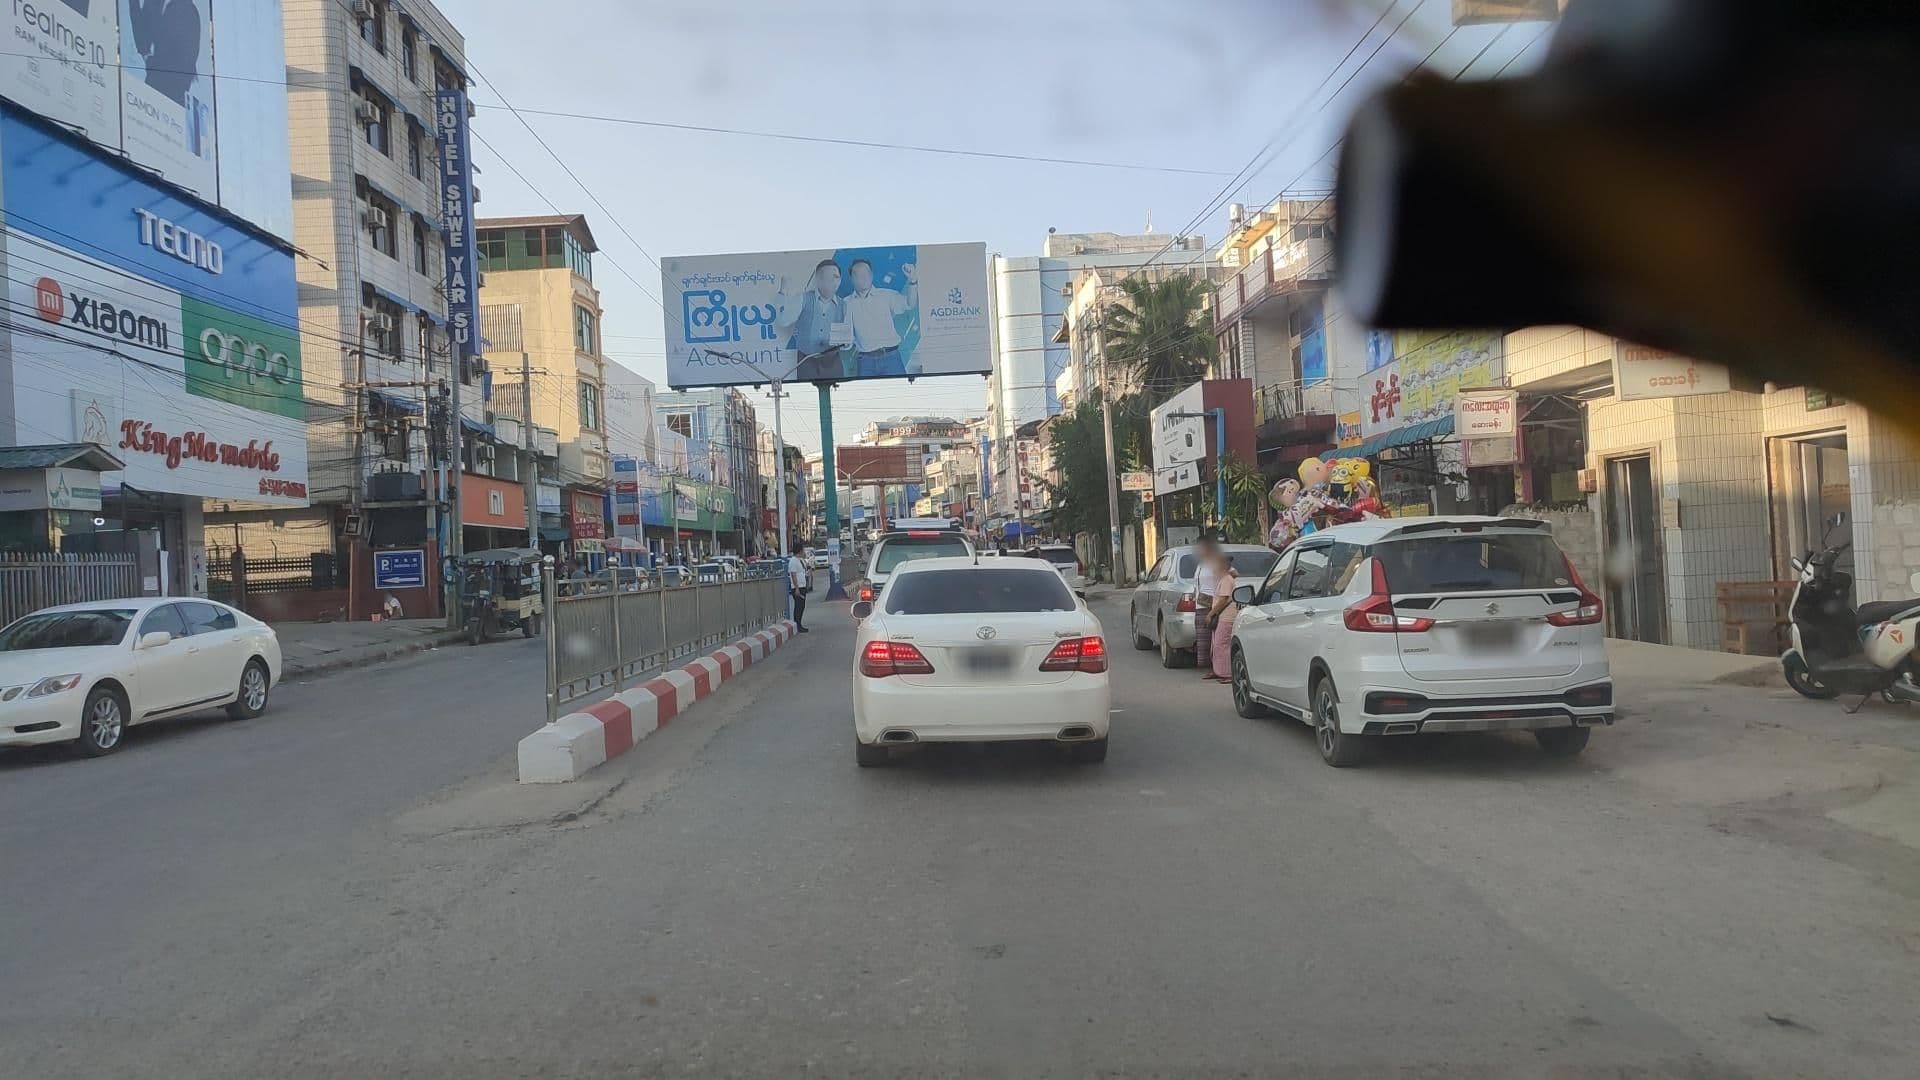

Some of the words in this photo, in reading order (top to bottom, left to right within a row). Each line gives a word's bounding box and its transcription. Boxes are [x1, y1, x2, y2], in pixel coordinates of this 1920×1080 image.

[13, 0, 86, 56] realme
[89, 40, 105, 69] 10
[441, 96, 459, 176] HOTEL
[133, 208, 222, 274] TECNO
[446, 184, 464, 248] SHWE
[450, 256, 466, 304] YAR
[454, 312, 469, 344] SU
[686, 346, 782, 367] Account
[118, 419, 182, 469] King
